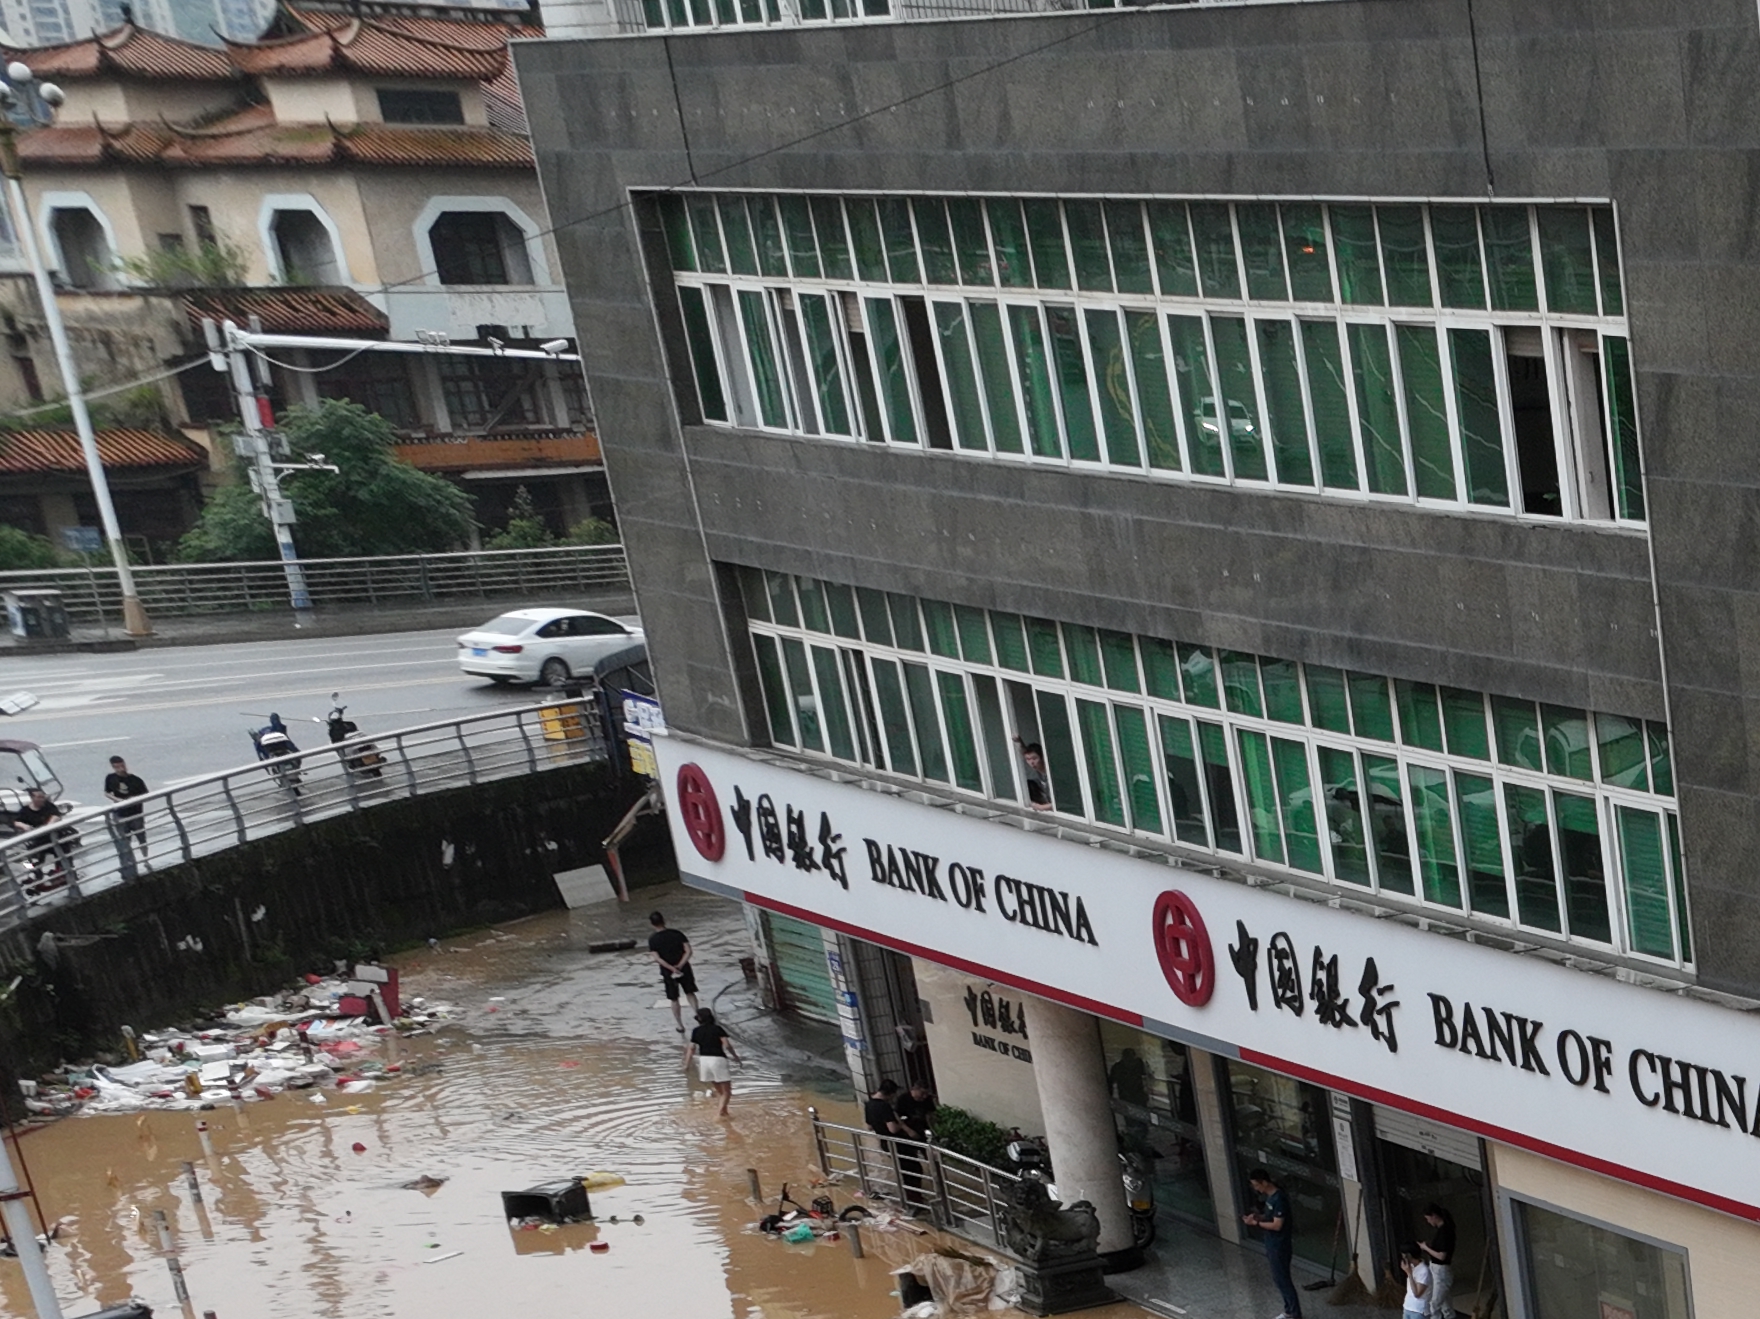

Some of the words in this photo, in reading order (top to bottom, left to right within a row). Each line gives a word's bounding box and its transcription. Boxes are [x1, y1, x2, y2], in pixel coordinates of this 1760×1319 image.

[731, 784, 849, 889] 中国银行
[863, 837, 941, 902] BANK
[948, 861, 987, 913] OF
[995, 873, 1098, 945] CHINA
[1228, 919, 1400, 1053] 中国银行
[1429, 992, 1550, 1075] BANK
[1557, 1028, 1613, 1094] OF
